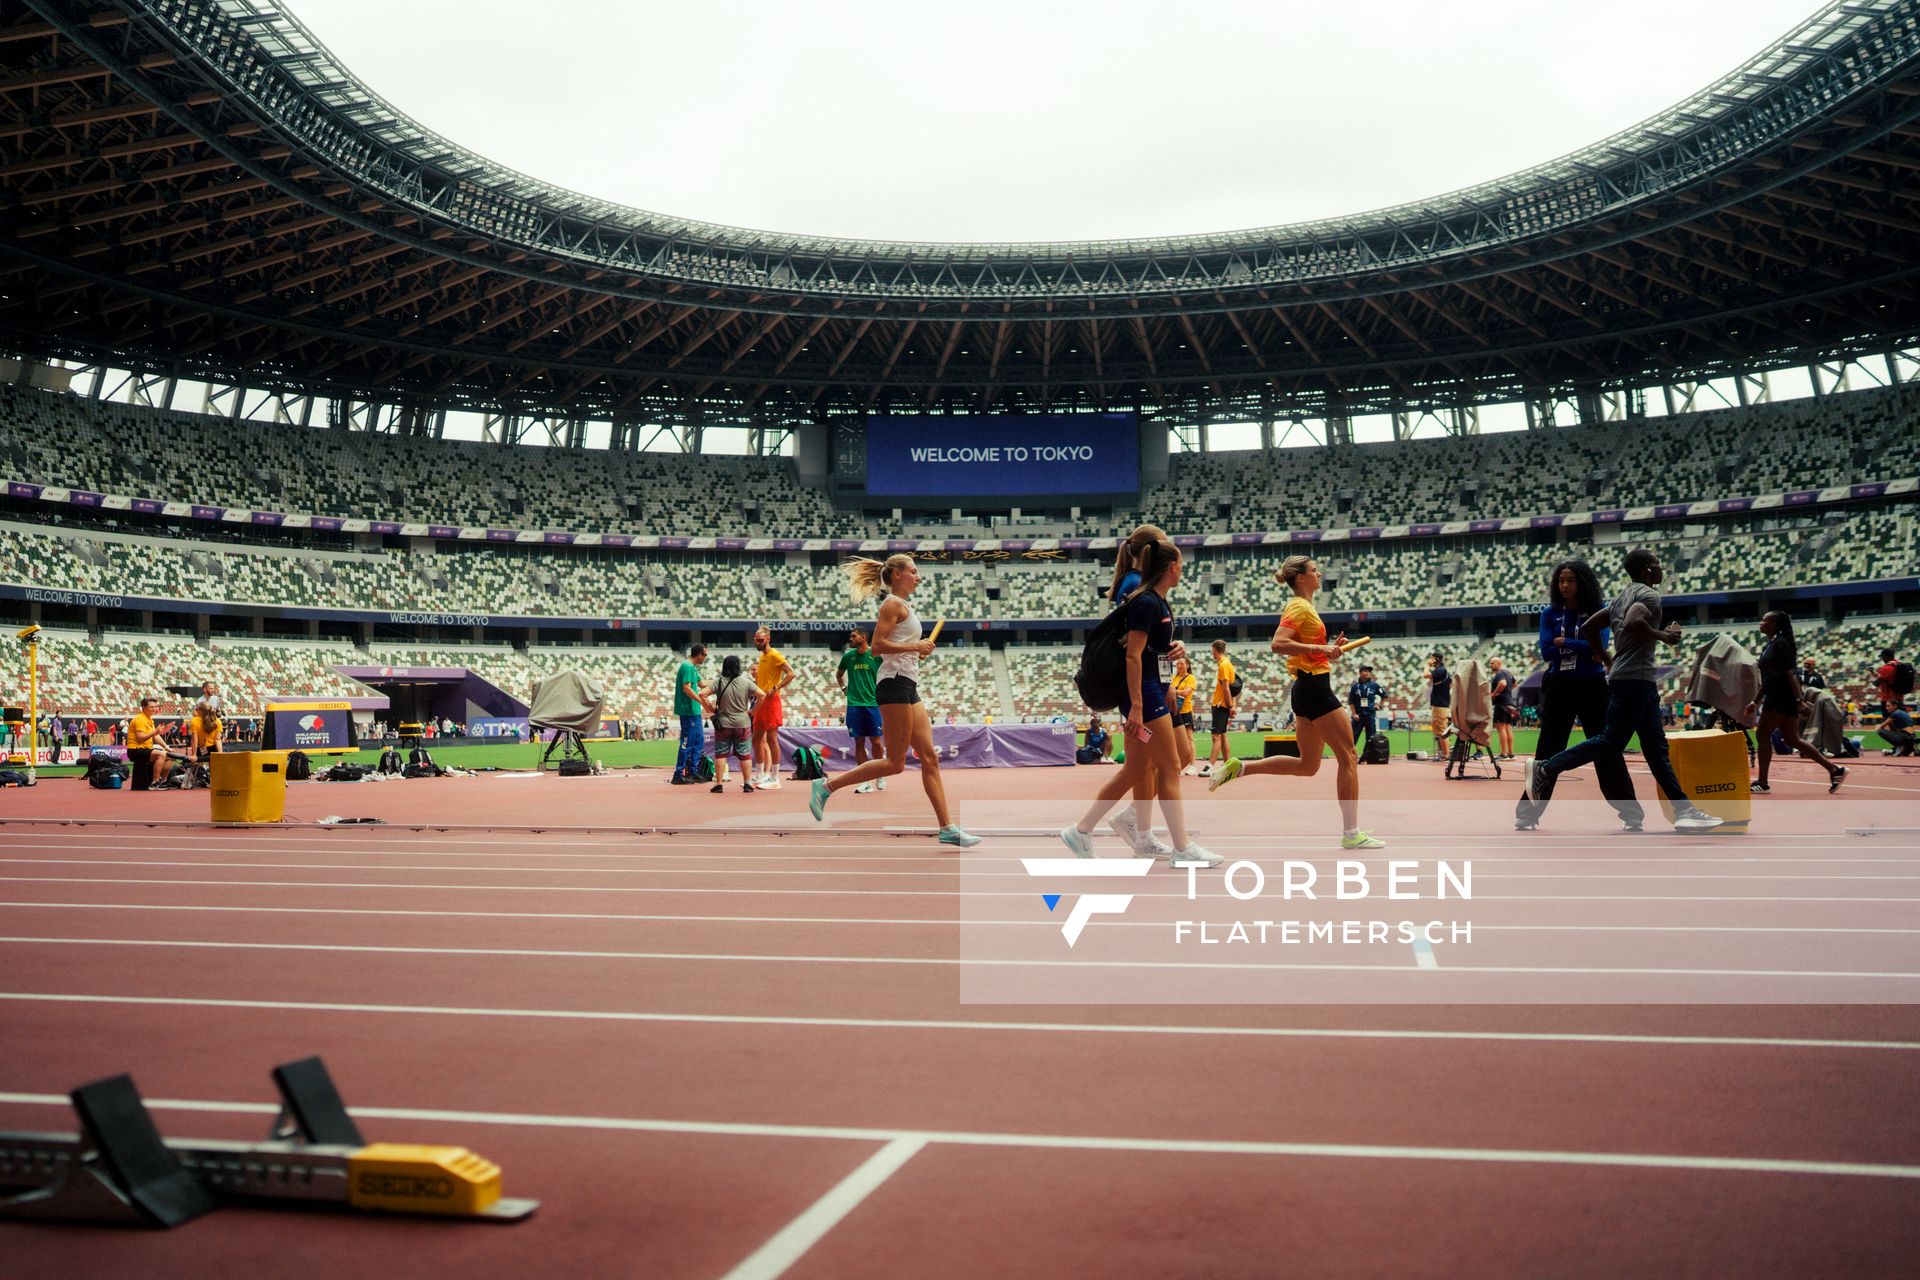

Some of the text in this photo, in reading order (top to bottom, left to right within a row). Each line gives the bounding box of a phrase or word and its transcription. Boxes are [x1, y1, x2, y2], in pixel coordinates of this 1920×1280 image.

[911, 446, 1093, 462] WELCOME TO TOKYO
[25, 589, 122, 607] WELCOME TO TOKYO
[1510, 604, 1551, 614] WELCO
[390, 613, 489, 625] WELCOME TO TOKYO
[1181, 617, 1194, 626] TO
[1197, 616, 1230, 626] TOKYO
[809, 622, 822, 631] TO
[824, 622, 857, 631] TOKYO
[38, 751, 75, 761] HODA
[215, 789, 240, 797] SEIKO
[1695, 782, 1736, 794] SEIKO
[358, 1173, 454, 1199] SEIKO
